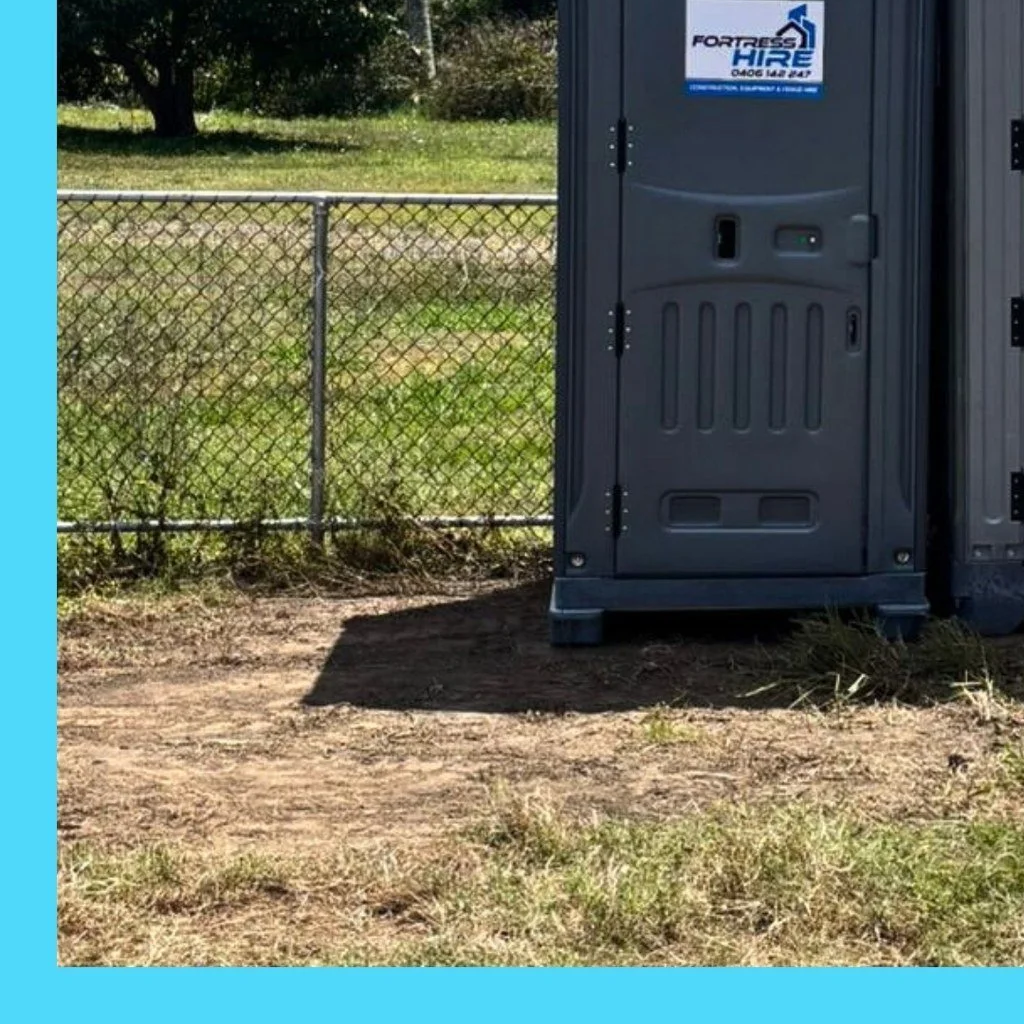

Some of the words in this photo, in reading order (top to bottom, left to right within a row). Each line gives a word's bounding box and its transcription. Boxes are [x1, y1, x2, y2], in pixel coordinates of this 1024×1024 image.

[691, 34, 797, 49] FORTRESS
[732, 48, 814, 68] HIRE
[731, 69, 763, 78] 0406
[766, 69, 786, 78] 142
[788, 70, 811, 79] 247
